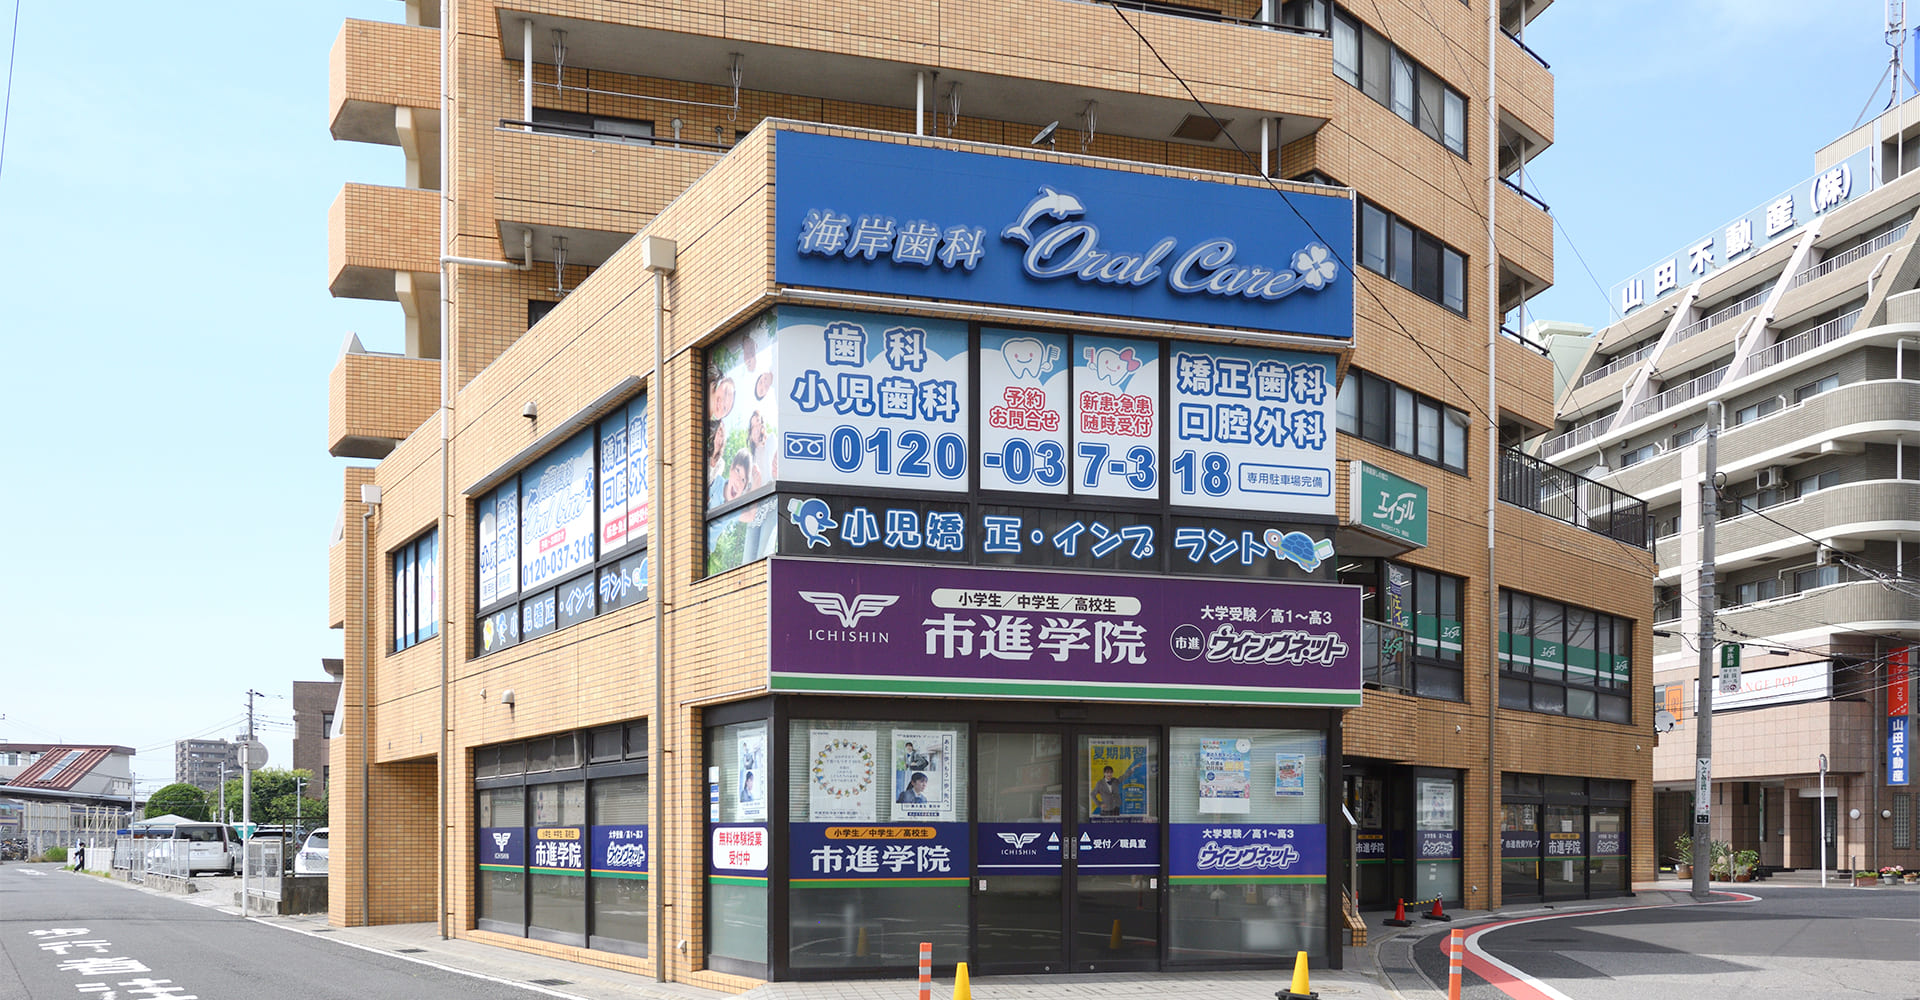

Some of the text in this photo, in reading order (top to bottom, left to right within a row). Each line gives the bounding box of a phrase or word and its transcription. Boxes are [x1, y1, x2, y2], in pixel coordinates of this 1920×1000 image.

[799, 208, 985, 270] 海岸歯科
[1024, 221, 1306, 299] Oral Care
[824, 321, 927, 372] 歯科
[1176, 353, 1327, 405] 矯正歯科
[791, 370, 960, 422] 小児歯科
[1004, 386, 1045, 410] 予約
[1080, 391, 1152, 416] 新患・急患
[989, 406, 1060, 431] お問合せ
[1080, 411, 1152, 437] 随時受付
[1179, 402, 1327, 450] 口腔外科
[1247, 472, 1323, 488] 専用駐車場完備
[1372, 491, 1417, 525] エイブル
[809, 629, 890, 643] ICHISHIN
[921, 613, 1148, 665] 市進学院
[1175, 635, 1200, 650] 市進
[1892, 719, 1905, 782] 山田不動産
[719, 831, 762, 847] 無料体験授業
[535, 841, 582, 868] 市進学院
[729, 850, 751, 866] 受付中
[810, 845, 951, 873] 市進学院
